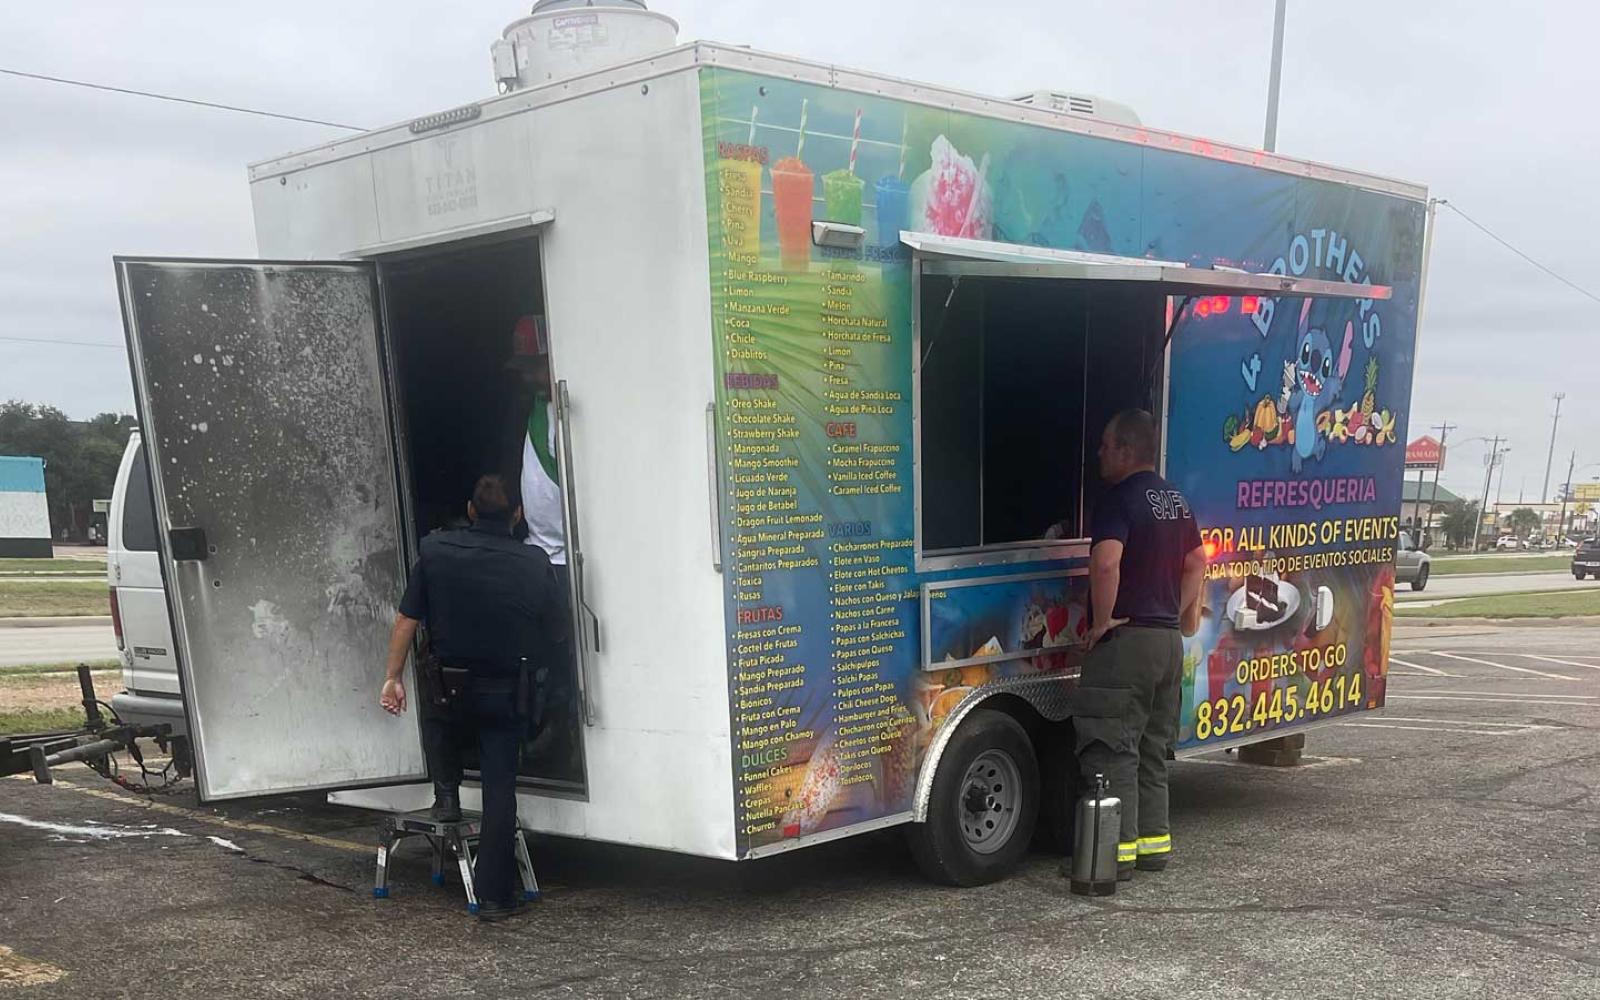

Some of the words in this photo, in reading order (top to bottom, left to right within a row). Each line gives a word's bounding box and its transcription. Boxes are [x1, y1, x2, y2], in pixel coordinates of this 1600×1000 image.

[728, 252, 757, 265] Mango
[728, 271, 748, 280] Blue
[748, 272, 788, 286] Raspberry
[730, 302, 766, 313] Manzana
[767, 303, 790, 314] Verde
[827, 301, 851, 311] Melon
[730, 318, 750, 328] Coca
[827, 316, 861, 327] Horchata
[862, 317, 888, 328] Natural
[730, 333, 756, 344] Chicle
[828, 331, 862, 341] Horchata
[873, 333, 892, 342] Fresa
[731, 348, 768, 360] Diablitos
[1241, 353, 1262, 391] 4
[829, 376, 849, 386] Fresa
[829, 391, 849, 402] Agua
[886, 391, 902, 400] Loca
[731, 400, 752, 409] Oreo
[753, 400, 777, 409] Shake
[829, 405, 849, 416] Agua
[878, 405, 893, 414] Loca
[732, 414, 771, 424] Chocolate
[772, 414, 796, 424] Shake
[732, 429, 776, 440] Strawberry
[776, 428, 800, 438] Shake
[826, 422, 857, 438] CAFE
[734, 444, 780, 456] Mangonada
[832, 444, 862, 454] Caramel
[863, 444, 900, 455] Frapuccino
[735, 459, 763, 471] Mango
[764, 458, 799, 468] Smoothie
[832, 458, 857, 467] Mocha
[858, 457, 896, 468] Frapuccino
[735, 473, 764, 484] Licuado
[766, 472, 789, 482] Verde
[833, 472, 858, 481] Vanilla
[858, 471, 874, 481] Iced
[875, 471, 897, 480] Coffee
[735, 489, 755, 500] Jugo
[756, 488, 766, 497] de
[768, 487, 797, 499] Naranja
[833, 486, 862, 496] Caramel
[880, 484, 902, 494] Coffee
[1236, 476, 1376, 511] REFRESQUERIA
[736, 503, 755, 514] Jugo
[756, 502, 767, 511] de
[769, 501, 798, 511] Betabel
[737, 517, 766, 528] Dragon
[767, 516, 784, 525] Fruit
[785, 513, 823, 524] Lemonade
[828, 521, 872, 537] VARIOS
[1200, 527, 1234, 551] FOR
[1236, 528, 1266, 552] ALL
[1269, 521, 1317, 549] KINDS
[1320, 520, 1342, 545] OF
[1344, 516, 1399, 541] EVENTS
[737, 533, 756, 544] Agua
[758, 531, 787, 542] Mineral
[788, 529, 824, 542] Preparada
[768, 545, 805, 558] Preparada
[833, 541, 879, 553] Chicharrones
[738, 562, 777, 573] Cantaritos
[778, 558, 818, 571] Preparados
[834, 557, 850, 567] Elote
[863, 555, 880, 564] Vaso
[1203, 563, 1227, 580] ARA
[1228, 561, 1260, 578] TODO
[1262, 557, 1286, 574] TIPO
[1287, 555, 1302, 572] DE
[1303, 551, 1347, 570] EVENTOS
[1348, 547, 1393, 565] SOCIALES
[834, 570, 851, 580] Elote
[868, 567, 881, 576] Hot
[882, 566, 908, 576] Cheetos
[834, 584, 851, 594] Elote
[868, 580, 886, 590] Takis
[739, 592, 761, 601] Rusas
[835, 596, 860, 606] Nachos
[861, 595, 875, 604] con
[876, 592, 898, 602] Queso
[736, 606, 783, 625] FRUTAS
[835, 609, 860, 620] Nachos
[862, 608, 875, 618] con
[876, 606, 896, 615] Carne
[836, 623, 857, 634] Papas
[870, 618, 899, 629] Francesa
[738, 630, 762, 641] Fresas
[762, 628, 776, 638] con
[778, 626, 801, 636] Crema
[836, 636, 857, 647] Papas
[858, 635, 870, 644] con
[872, 630, 905, 642] Salchichas
[738, 644, 762, 655] Coctel
[764, 642, 774, 651] de
[775, 640, 798, 650] Frutas
[836, 649, 858, 660] Papas
[872, 645, 893, 656] Queso
[738, 658, 758, 668] Fruta
[760, 654, 784, 665] Picada
[837, 659, 880, 673] Salchipulpos
[1236, 652, 1298, 684] ORDERS
[1300, 648, 1320, 671] TO
[1324, 643, 1346, 667] GO
[739, 672, 766, 684] Mango
[768, 665, 805, 679] Preparado
[859, 673, 878, 684] Papas
[768, 679, 804, 692] Preparada
[838, 687, 860, 698] Pulpos
[862, 685, 874, 694] con
[875, 683, 895, 694] Papas
[838, 700, 854, 710] Chili
[855, 698, 880, 709] Cheese
[880, 694, 898, 706] Dogs
[1196, 673, 1362, 741] 832.445.4614
[741, 712, 761, 723] Fruta
[762, 710, 776, 720] con
[778, 706, 801, 716] Crema
[839, 711, 877, 724] Hamburger
[742, 725, 768, 737] Mango
[770, 723, 780, 732] en
[781, 719, 796, 730] Palo
[840, 724, 875, 736] Chicharron
[742, 739, 770, 751] Mango
[770, 736, 784, 745] con
[785, 729, 814, 741] Chamoy
[840, 738, 868, 749] Cheetos
[881, 731, 902, 742] Queso
[871, 745, 892, 756] Queso
[740, 747, 788, 768] DULCES
[744, 771, 770, 782] Funnel
[770, 766, 792, 777] Cakes
[744, 784, 772, 795] Waffles
[745, 797, 770, 809] Crepas
[746, 809, 774, 821] Nutella
[746, 822, 776, 835] Churros
